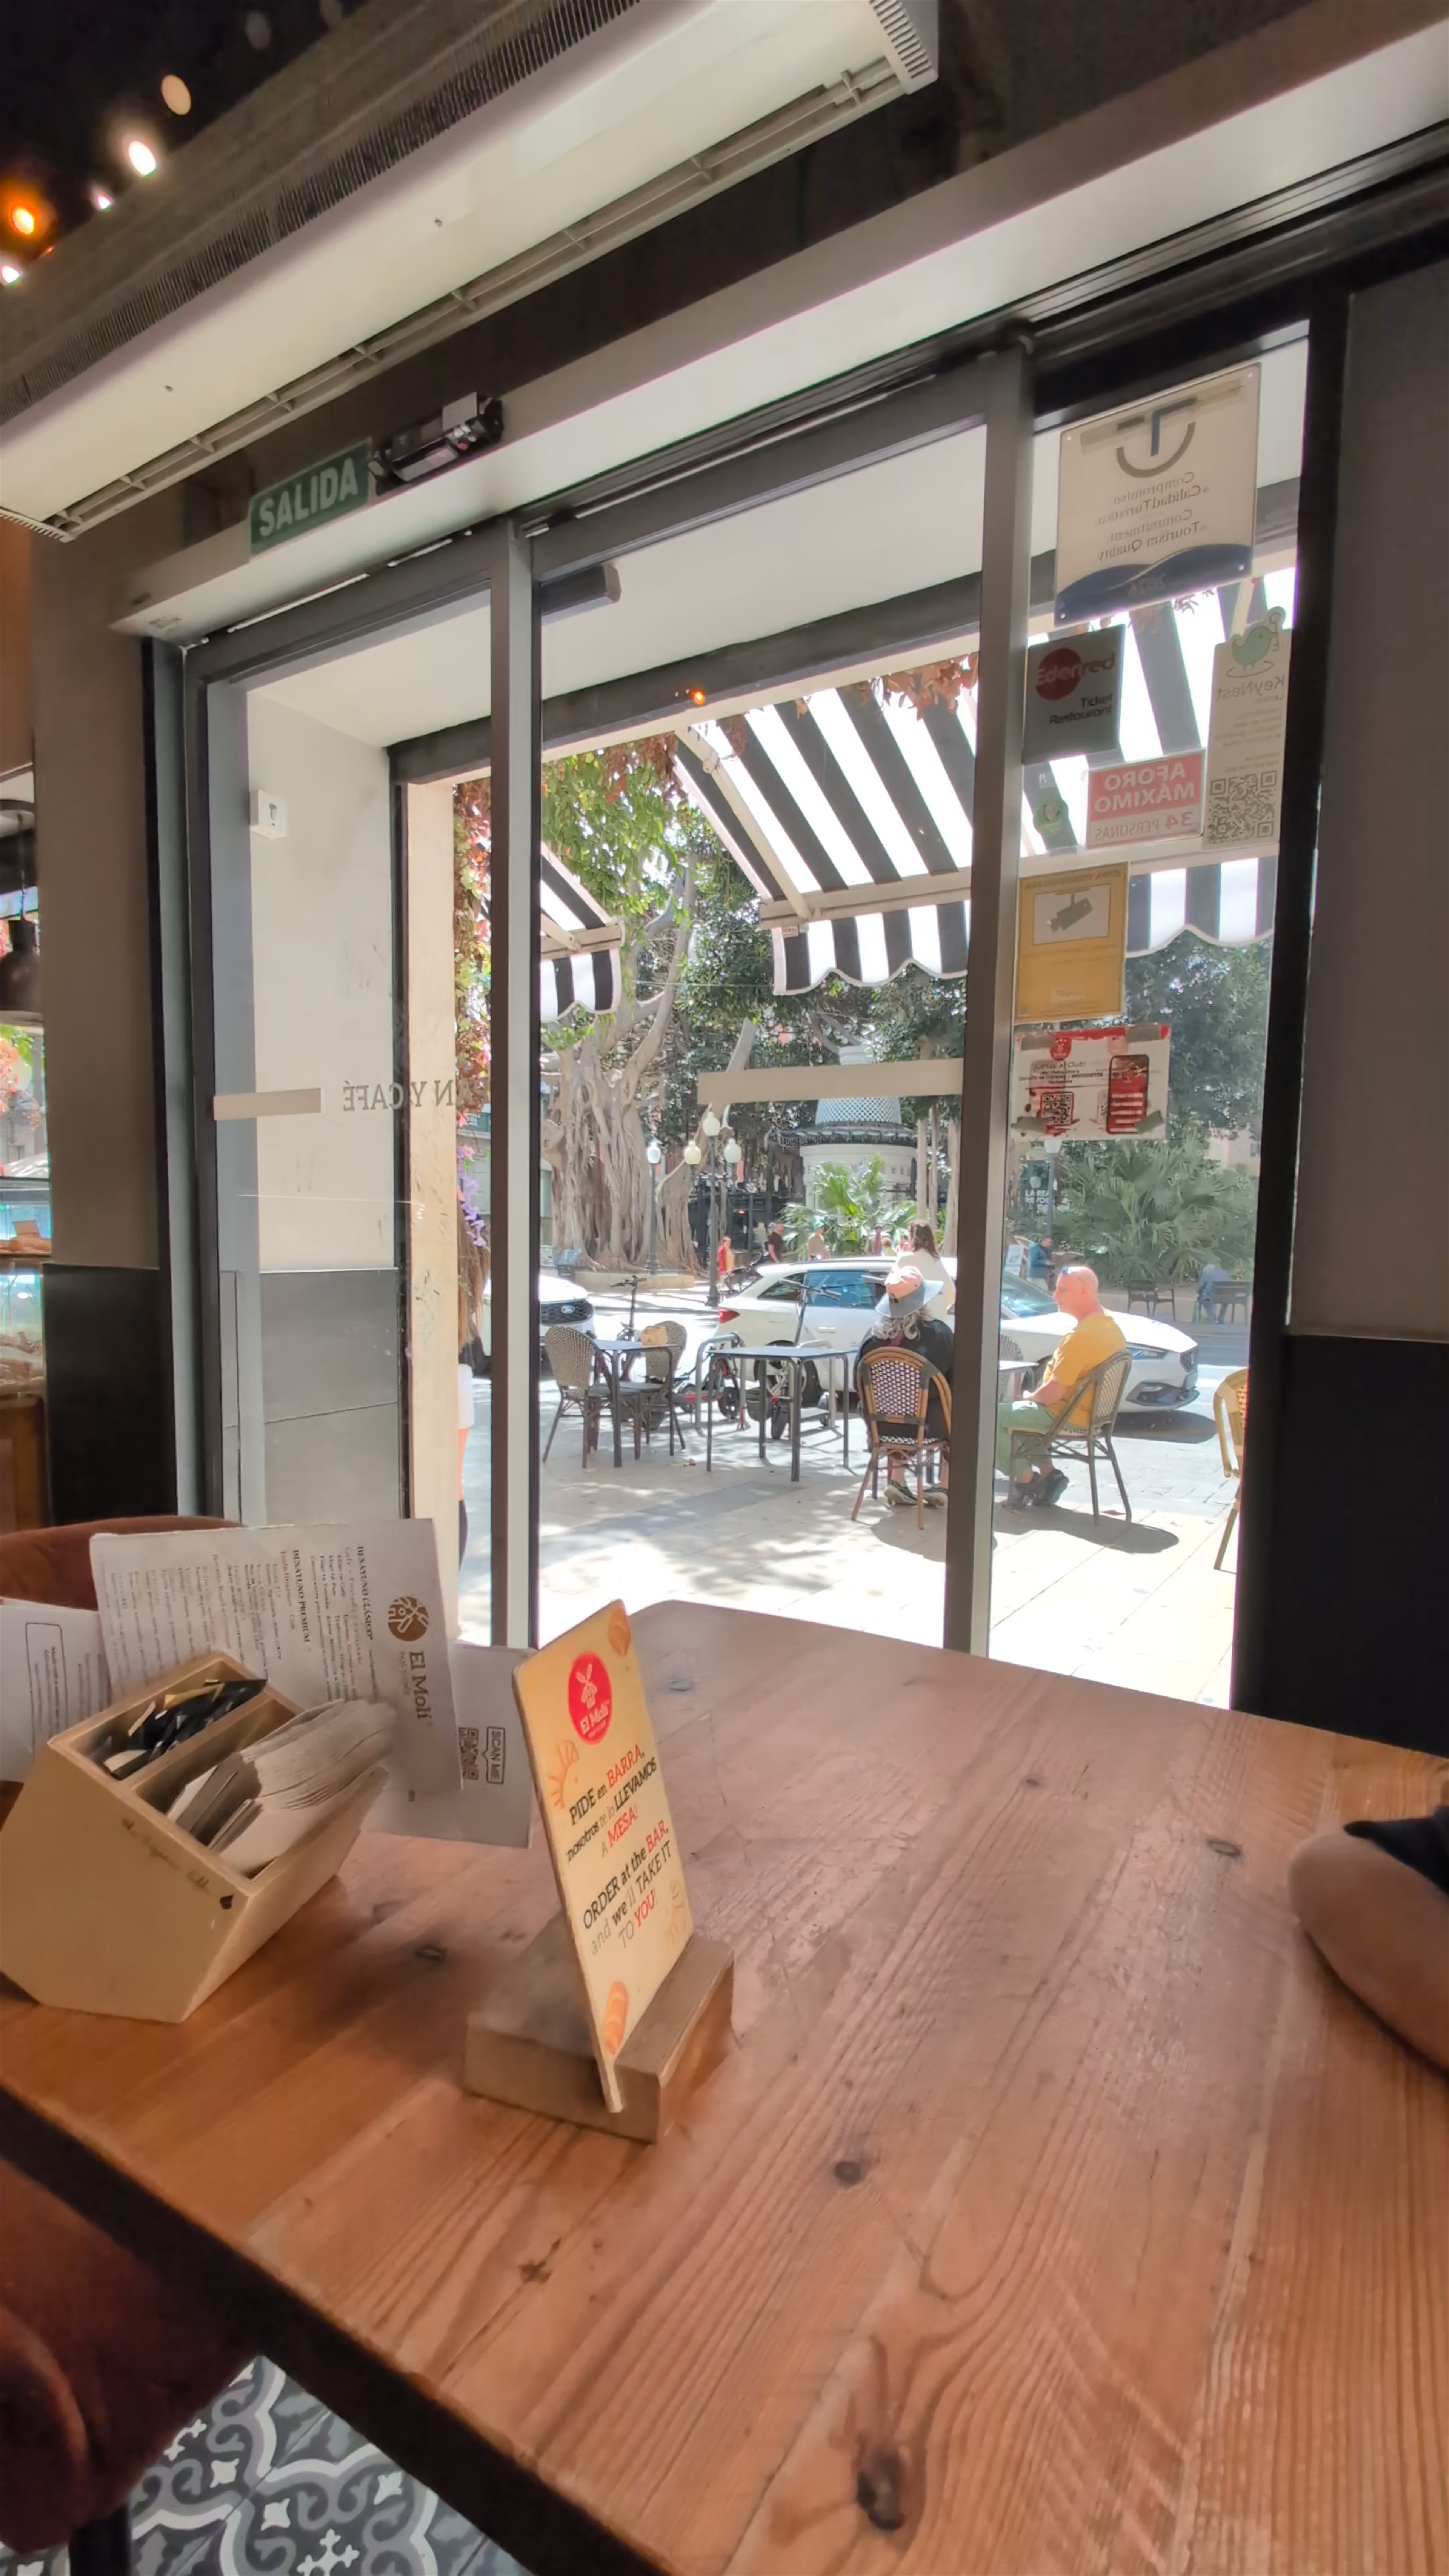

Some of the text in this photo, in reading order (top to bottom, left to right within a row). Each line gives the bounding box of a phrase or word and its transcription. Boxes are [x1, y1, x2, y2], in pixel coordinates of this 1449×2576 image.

[259, 457, 358, 537] SALIDA
[1037, 650, 1116, 685] Edenred
[1081, 693, 1113, 708] Ticket
[410, 1651, 432, 1719] El Molí
[491, 1730, 501, 1780] SCAN ME
[580, 1716, 591, 1735] El
[566, 1821, 600, 1863] nosotros
[599, 1812, 608, 1827] te
[614, 1756, 657, 1811] LLEVAMOS
[569, 1744, 645, 1826] PIDE en BARRA,
[583, 1819, 669, 1929] ORDER at the BAR,
[601, 1841, 608, 1858] A
[591, 1918, 611, 1956] and
[635, 1852, 662, 1895] TAKE
[661, 1840, 671, 1864] IT
[618, 1920, 634, 1949] TO
